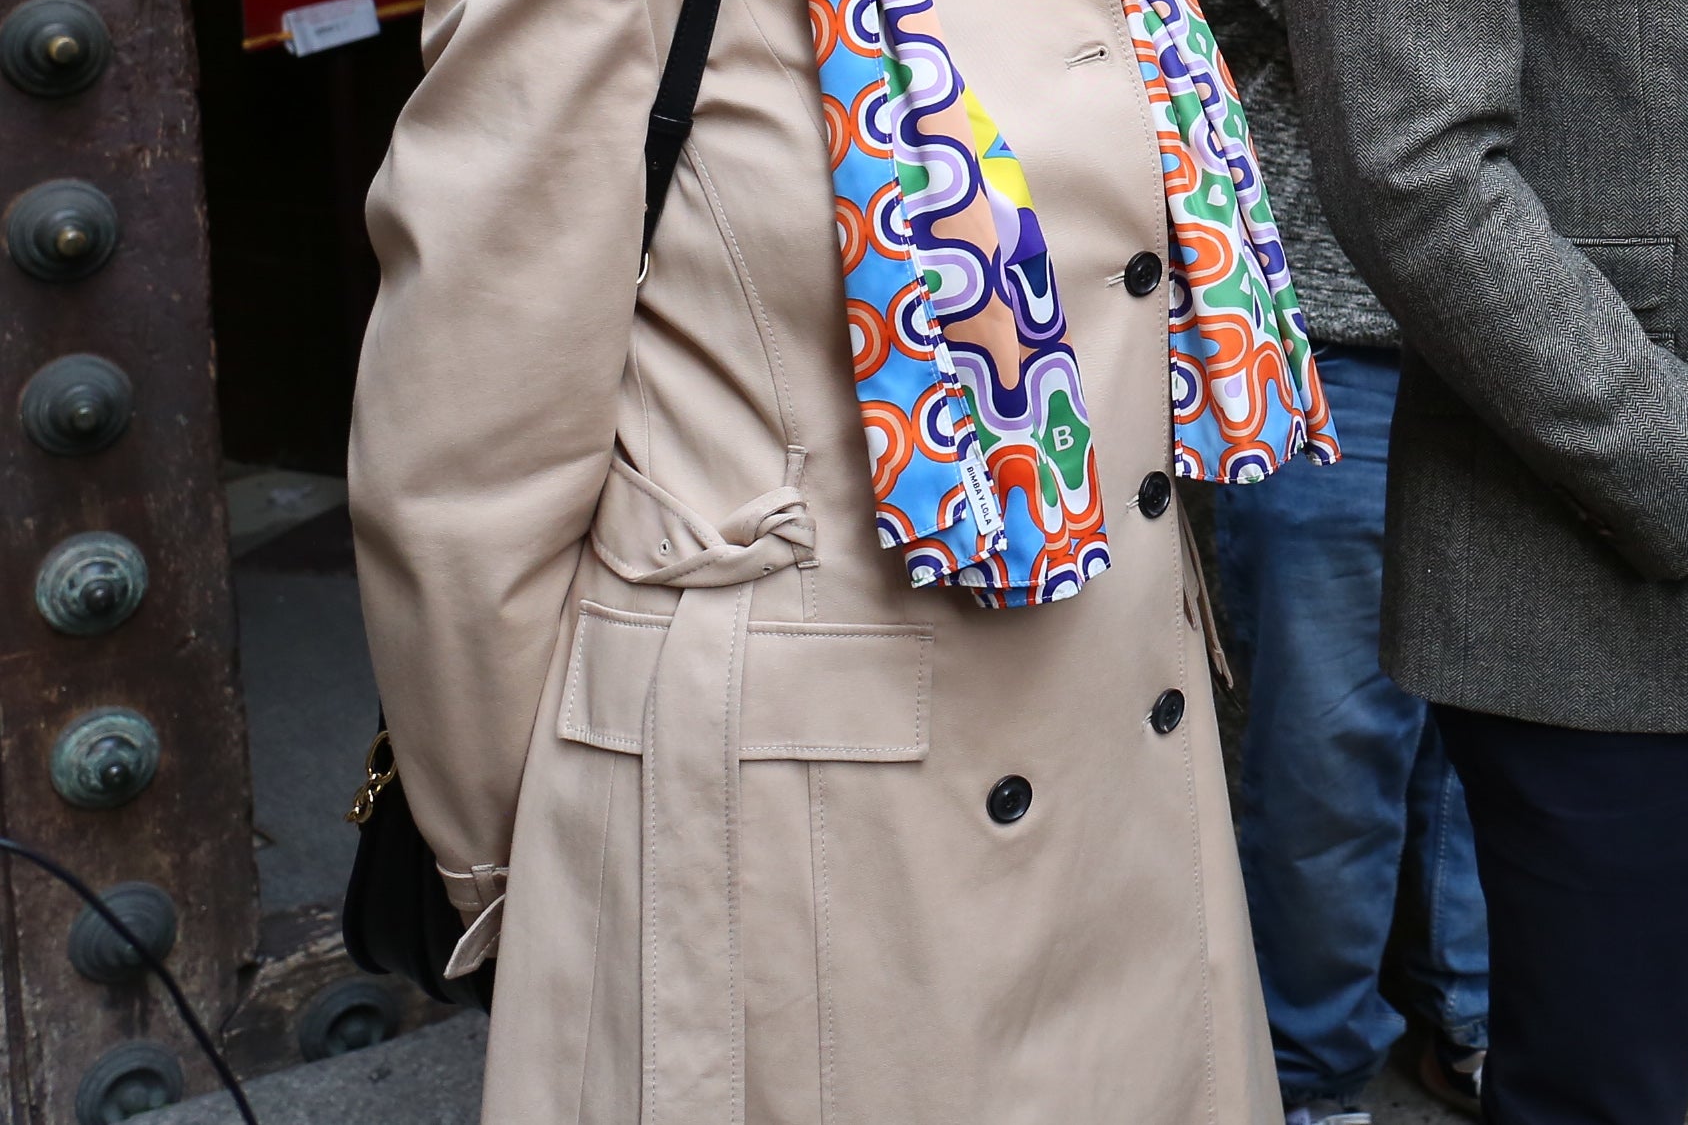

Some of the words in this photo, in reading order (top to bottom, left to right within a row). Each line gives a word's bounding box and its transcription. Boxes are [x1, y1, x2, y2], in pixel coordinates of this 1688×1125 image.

[1052, 425, 1075, 452] B
[966, 466, 983, 495] BIMBA
[979, 494, 986, 502] Y
[980, 502, 992, 526] LOLA
